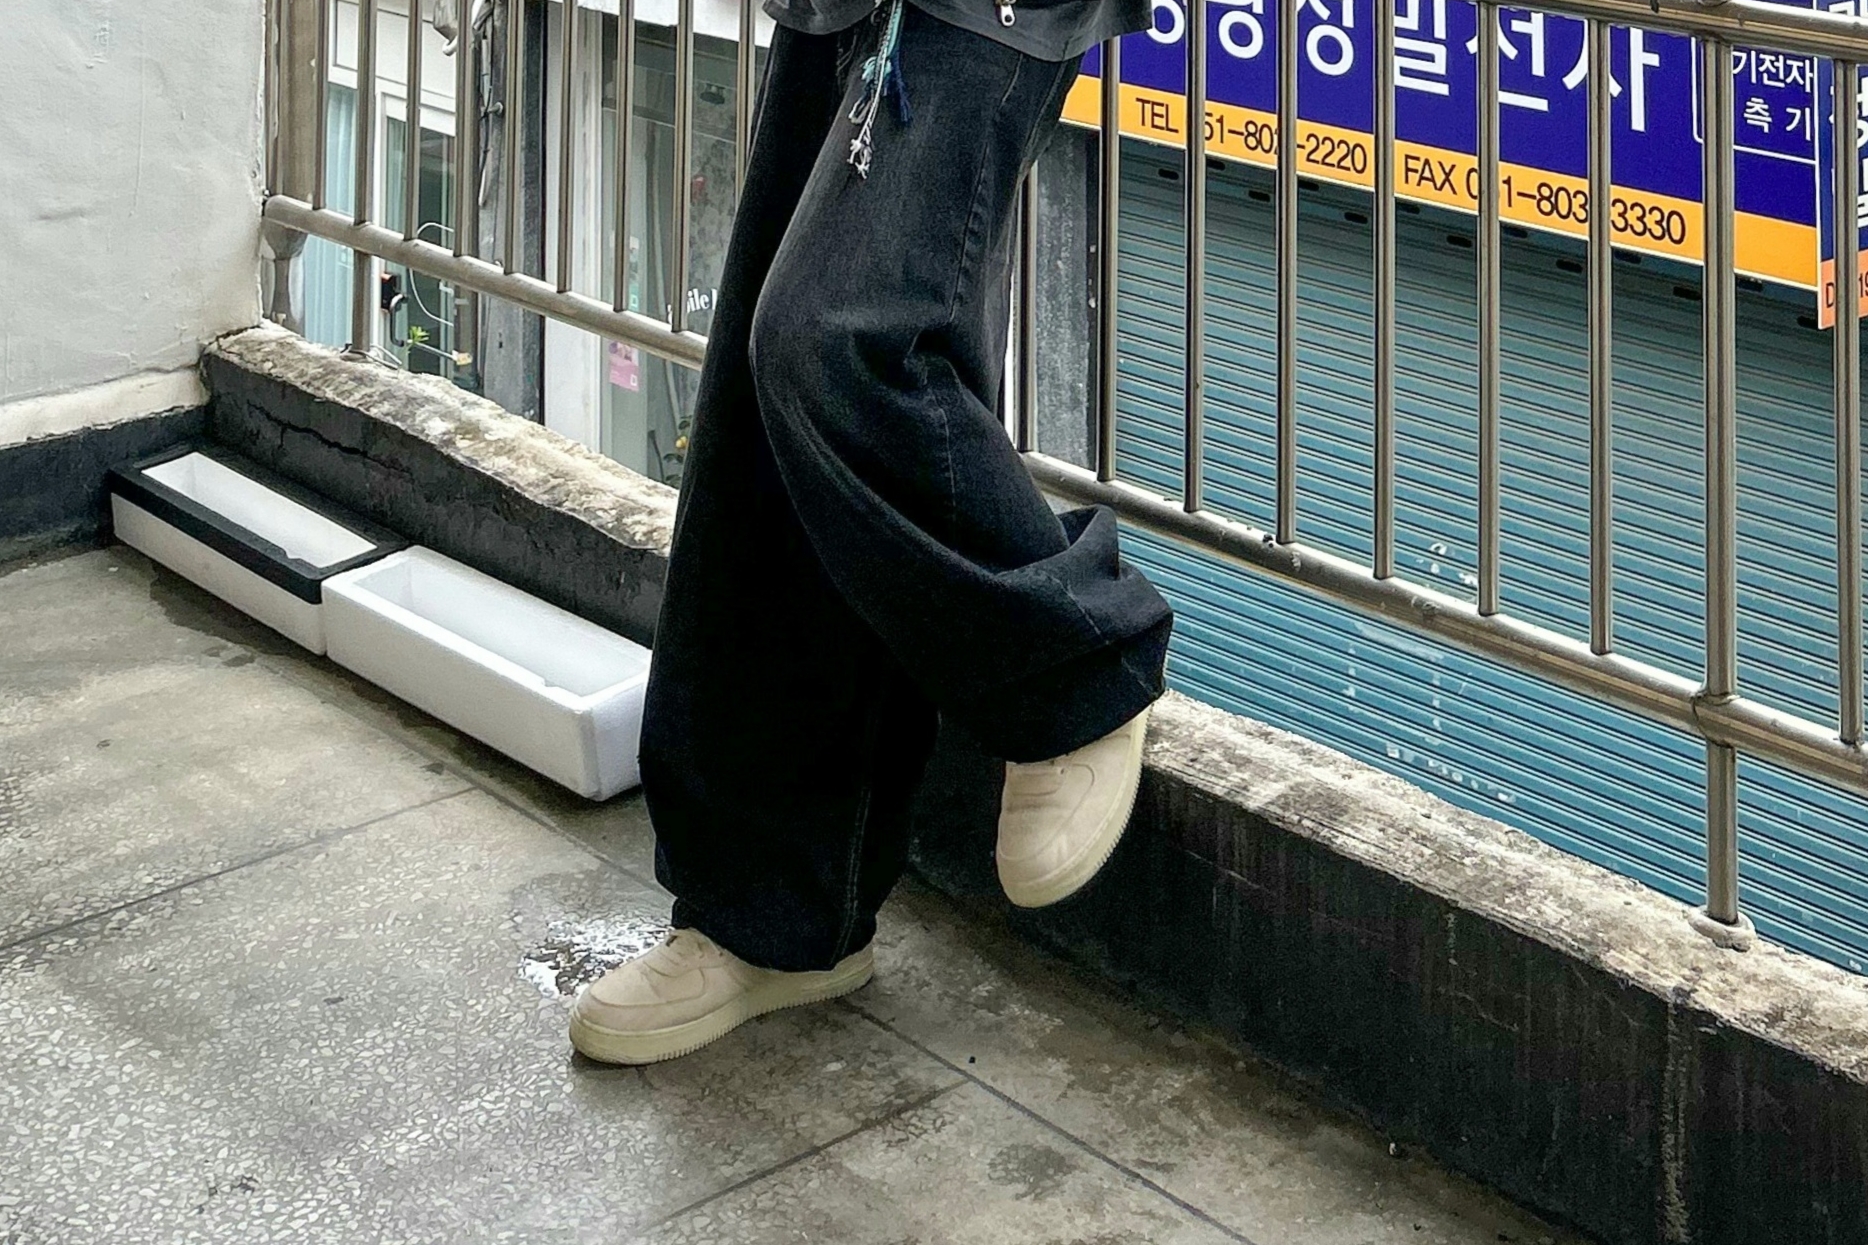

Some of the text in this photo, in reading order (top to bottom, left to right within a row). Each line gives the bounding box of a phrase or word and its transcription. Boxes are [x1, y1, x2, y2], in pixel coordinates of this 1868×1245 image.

[1731, 50, 1814, 93] 기전자
[1135, 97, 1180, 134] TEL
[1403, 153, 1458, 196] FAX
